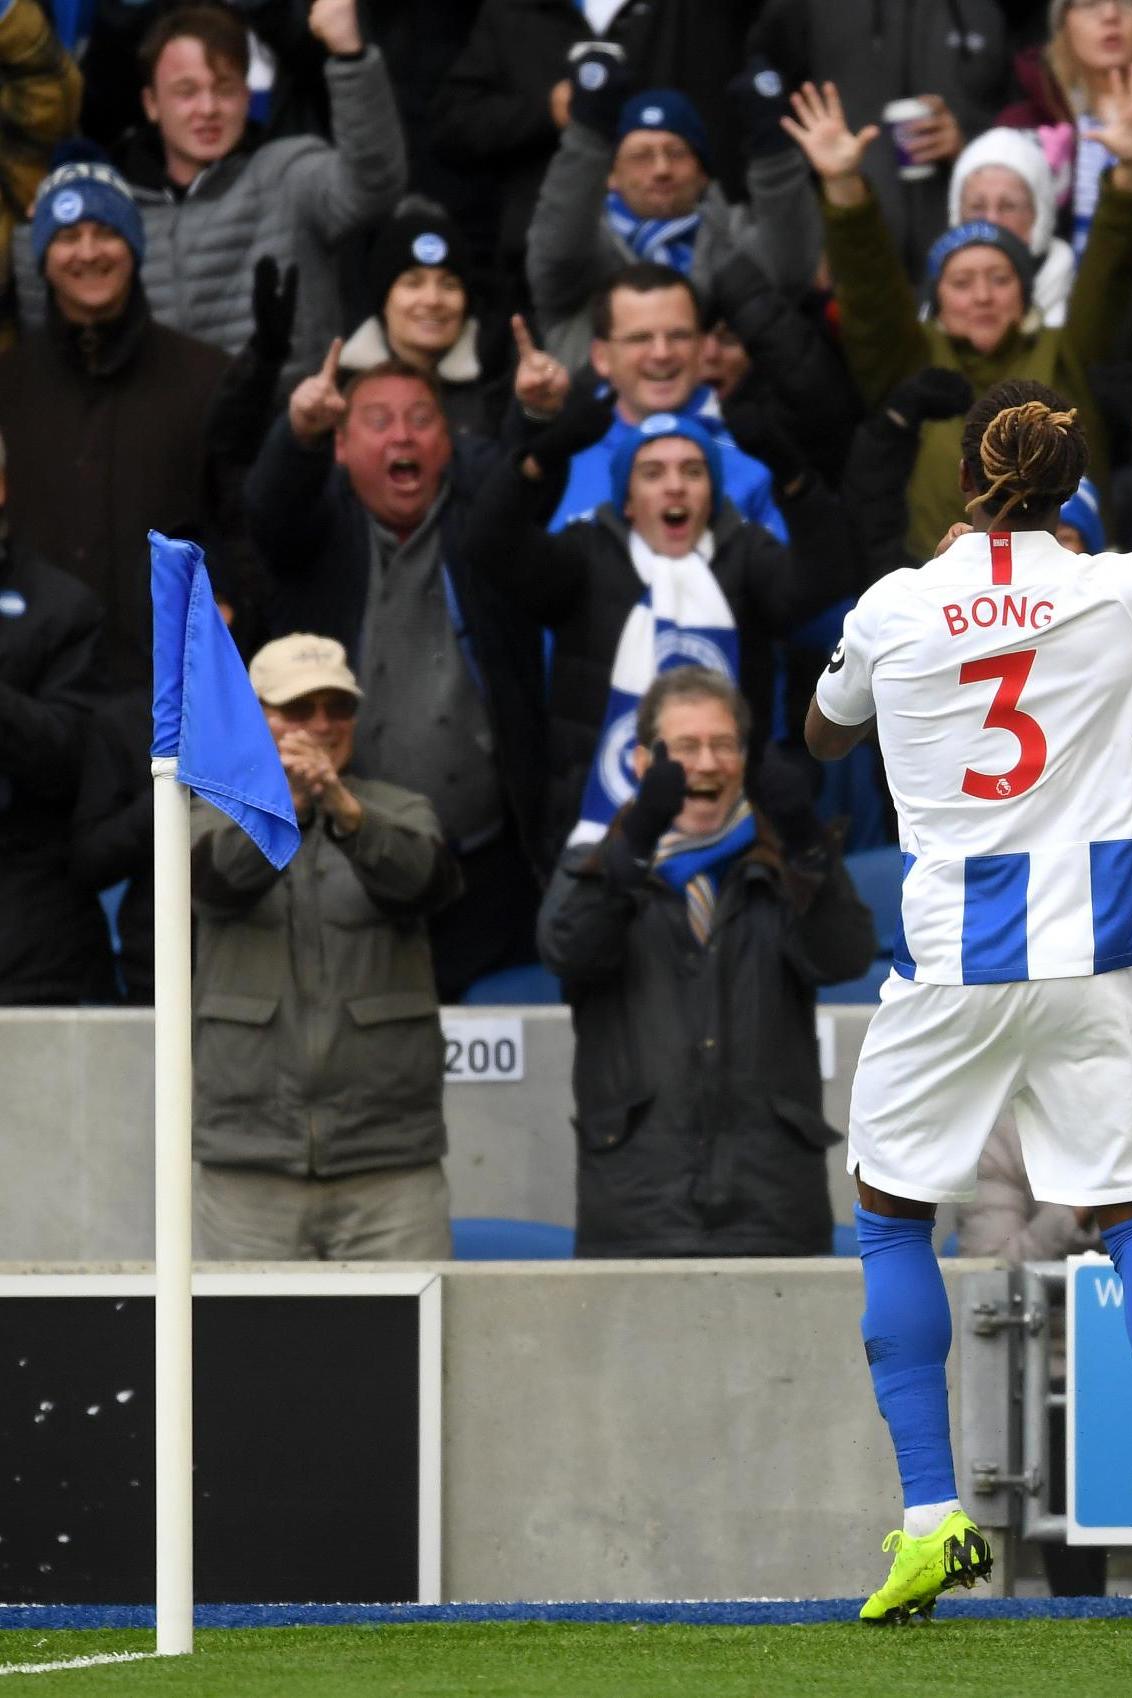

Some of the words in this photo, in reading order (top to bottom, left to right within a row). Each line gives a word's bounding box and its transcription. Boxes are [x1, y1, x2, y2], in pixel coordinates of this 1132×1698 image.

[942, 594, 1054, 636] BONG
[958, 648, 1048, 801] 3
[444, 1039, 516, 1074] 200
